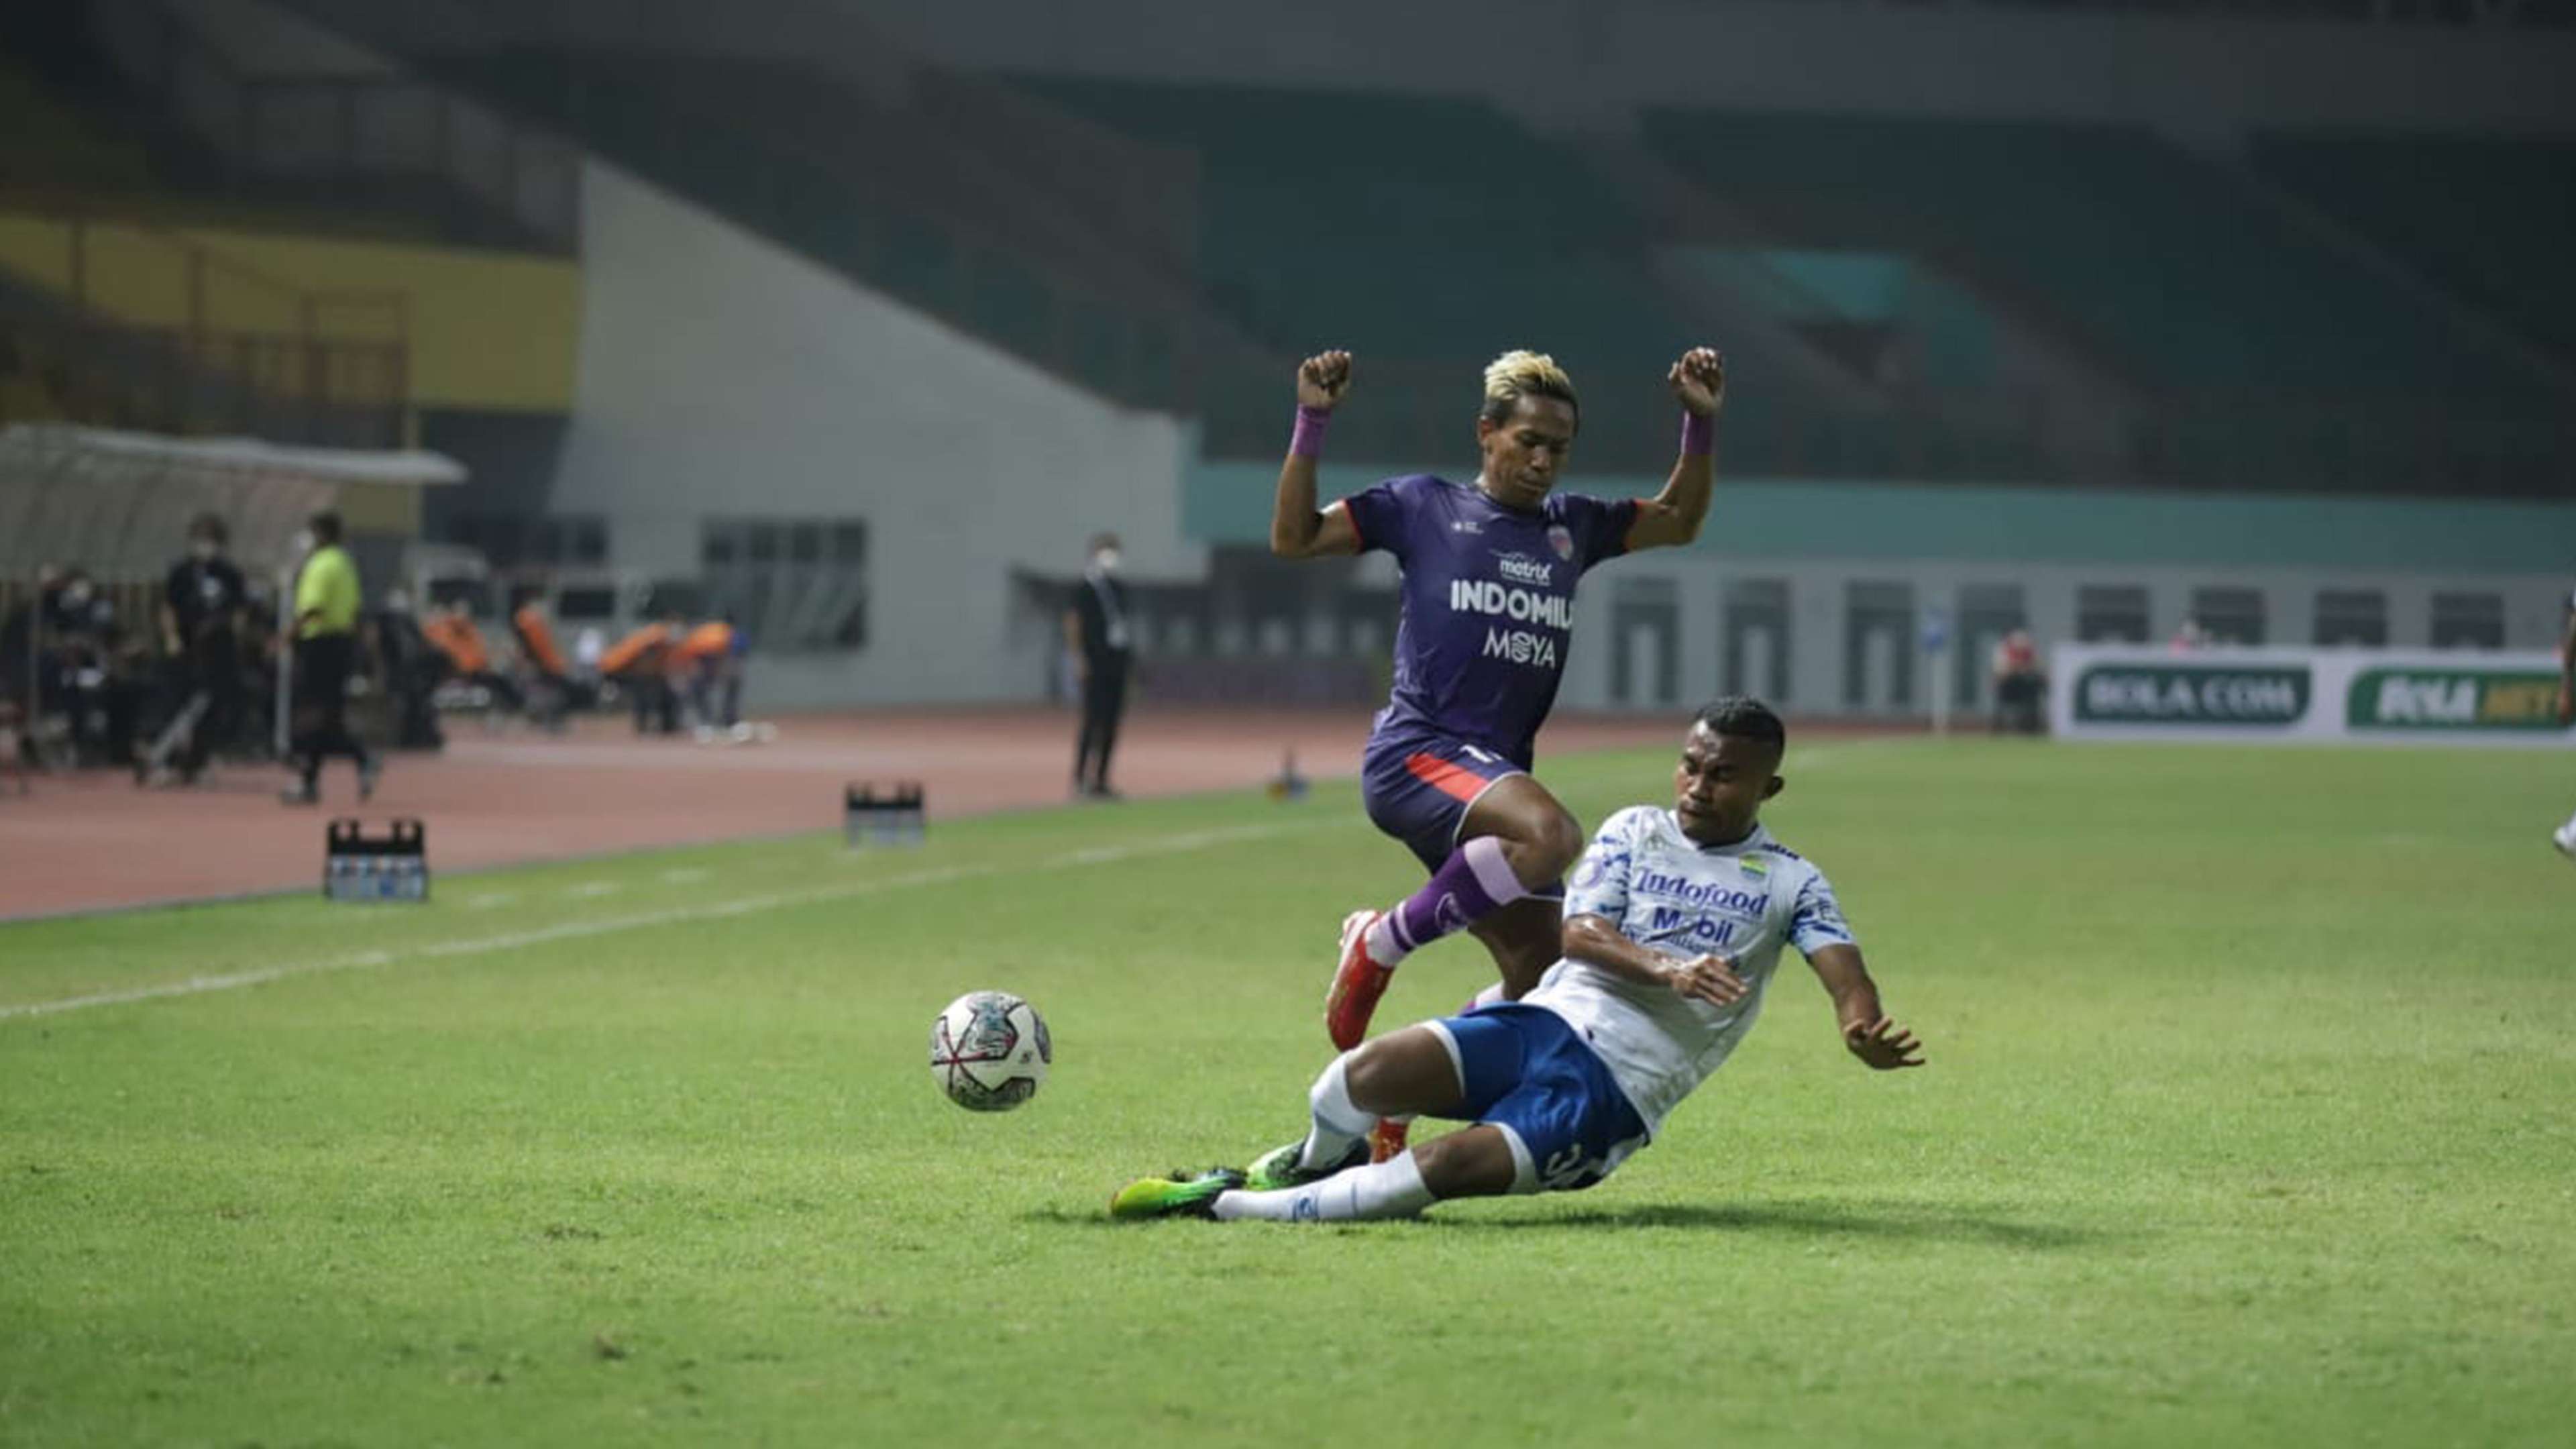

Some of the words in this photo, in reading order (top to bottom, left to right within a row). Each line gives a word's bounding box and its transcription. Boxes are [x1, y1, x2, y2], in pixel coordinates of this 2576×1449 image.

[1450, 579, 1572, 630] INDOMIL
[1481, 625, 1556, 670] MOYA
[1635, 867, 1770, 915] Indofood
[1653, 906, 1733, 946] Mbil
